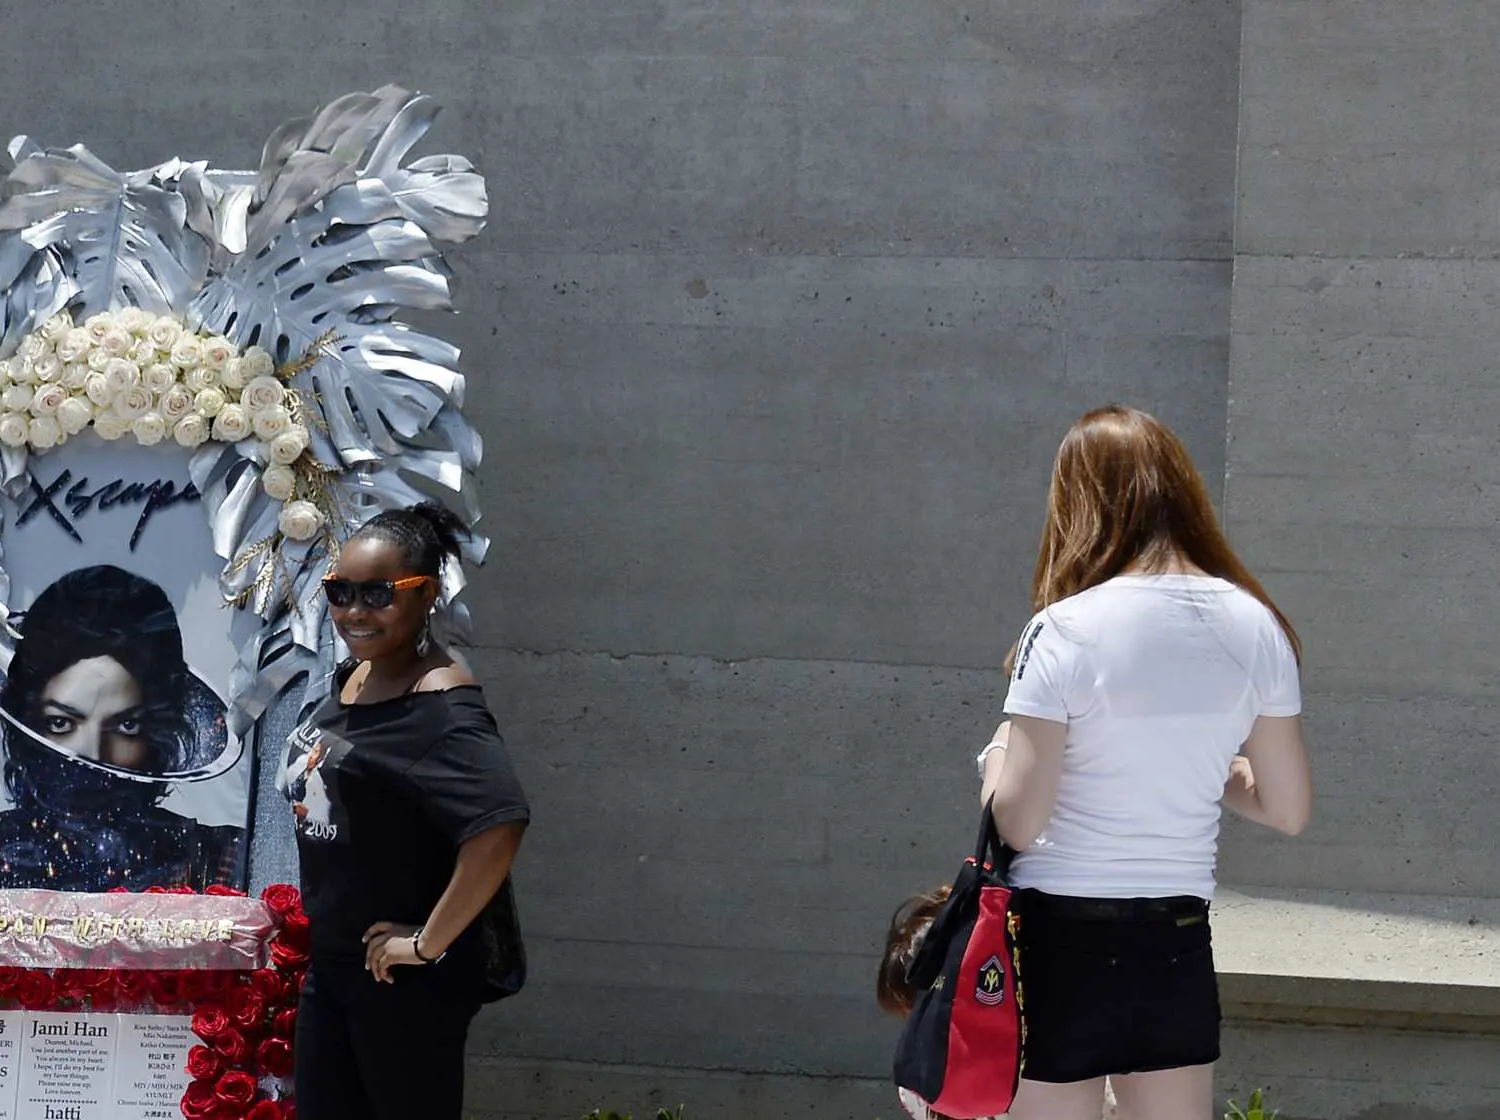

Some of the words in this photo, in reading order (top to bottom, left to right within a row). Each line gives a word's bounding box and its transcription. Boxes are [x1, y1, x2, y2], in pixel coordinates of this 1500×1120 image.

[305, 821, 337, 840] 2009
[74, 916, 144, 938] WITH
[162, 917, 235, 941] LOVE
[30, 1020, 68, 1038] Jami
[74, 1022, 108, 1037] Han
[45, 1105, 81, 1120] hatti
